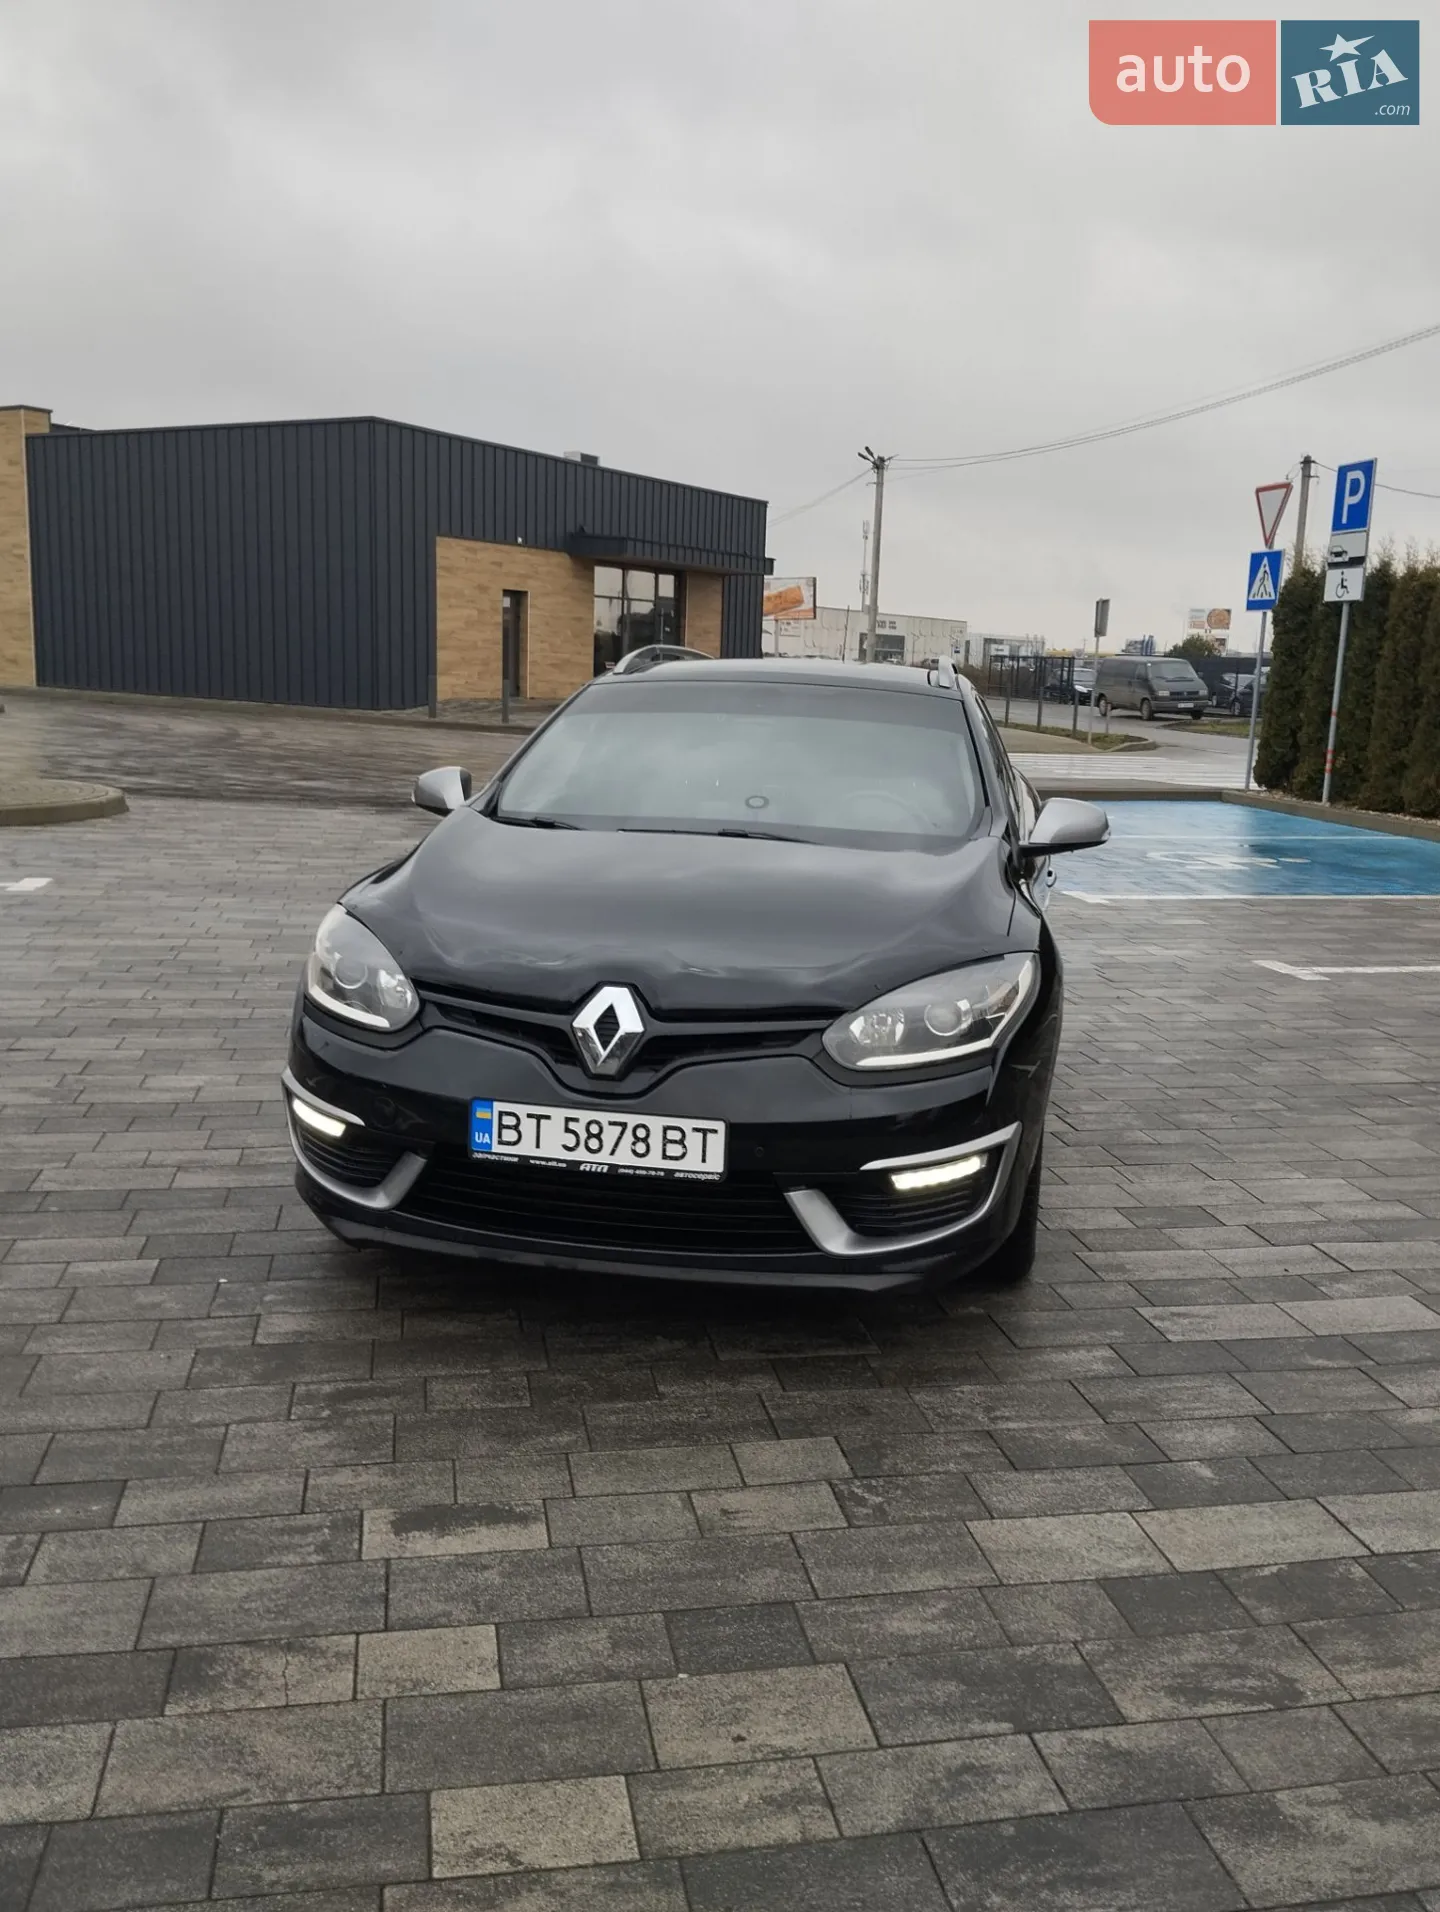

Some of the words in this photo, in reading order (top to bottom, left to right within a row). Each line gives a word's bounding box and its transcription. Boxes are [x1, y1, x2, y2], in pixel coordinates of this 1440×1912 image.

[1342, 469, 1366, 524] P
[474, 1131, 491, 1145] UA
[497, 1111, 551, 1149] BT
[561, 1116, 651, 1158] 5878
[662, 1124, 719, 1164] BT
